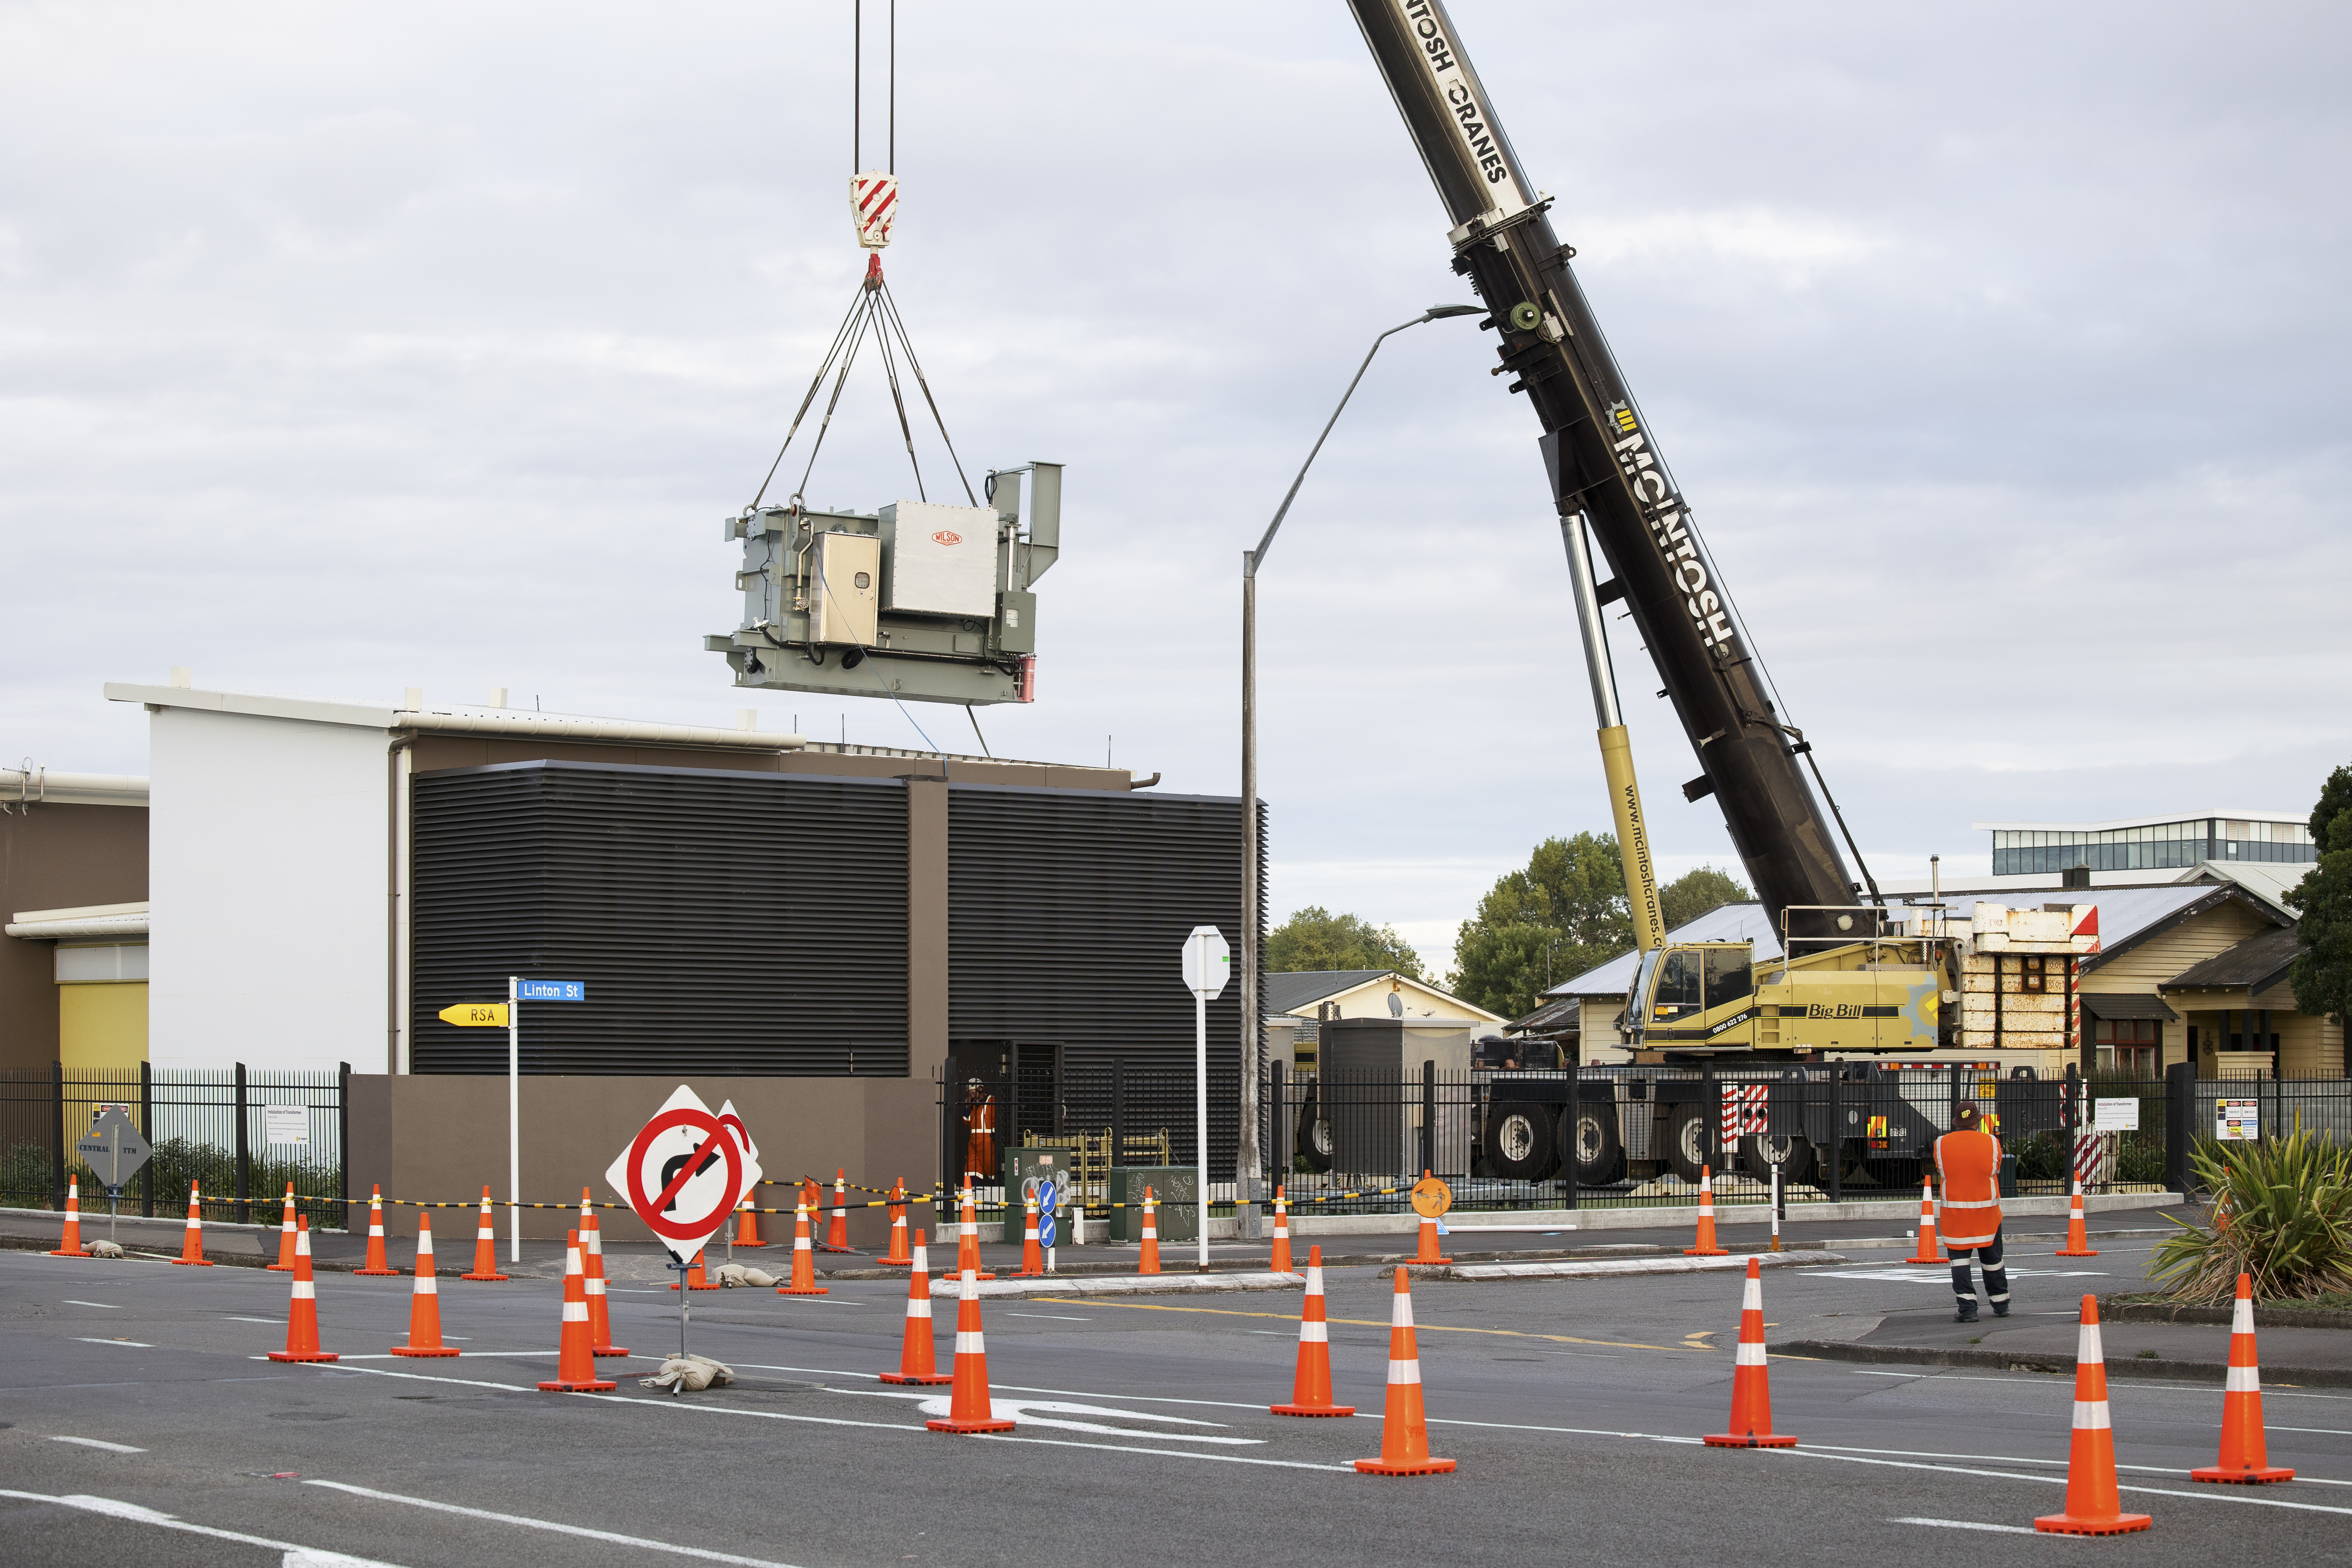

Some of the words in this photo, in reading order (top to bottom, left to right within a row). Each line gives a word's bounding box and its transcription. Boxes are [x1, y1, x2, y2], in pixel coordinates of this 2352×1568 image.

[1449, 84, 1507, 184] CRANES
[935, 533, 959, 542] WILSON
[525, 984, 560, 997] Linton
[566, 985, 578, 998] St
[471, 1009, 495, 1021] RSA
[1809, 1004, 1835, 1019] Big
[1836, 1004, 1861, 1017] Bill
[1713, 1023, 1727, 1034] 0800
[1727, 1018, 1737, 1027] 622
[1737, 1013, 1748, 1023] 276
[1961, 1110, 1970, 1119] L&P
[79, 1144, 110, 1152] CENTRAL
